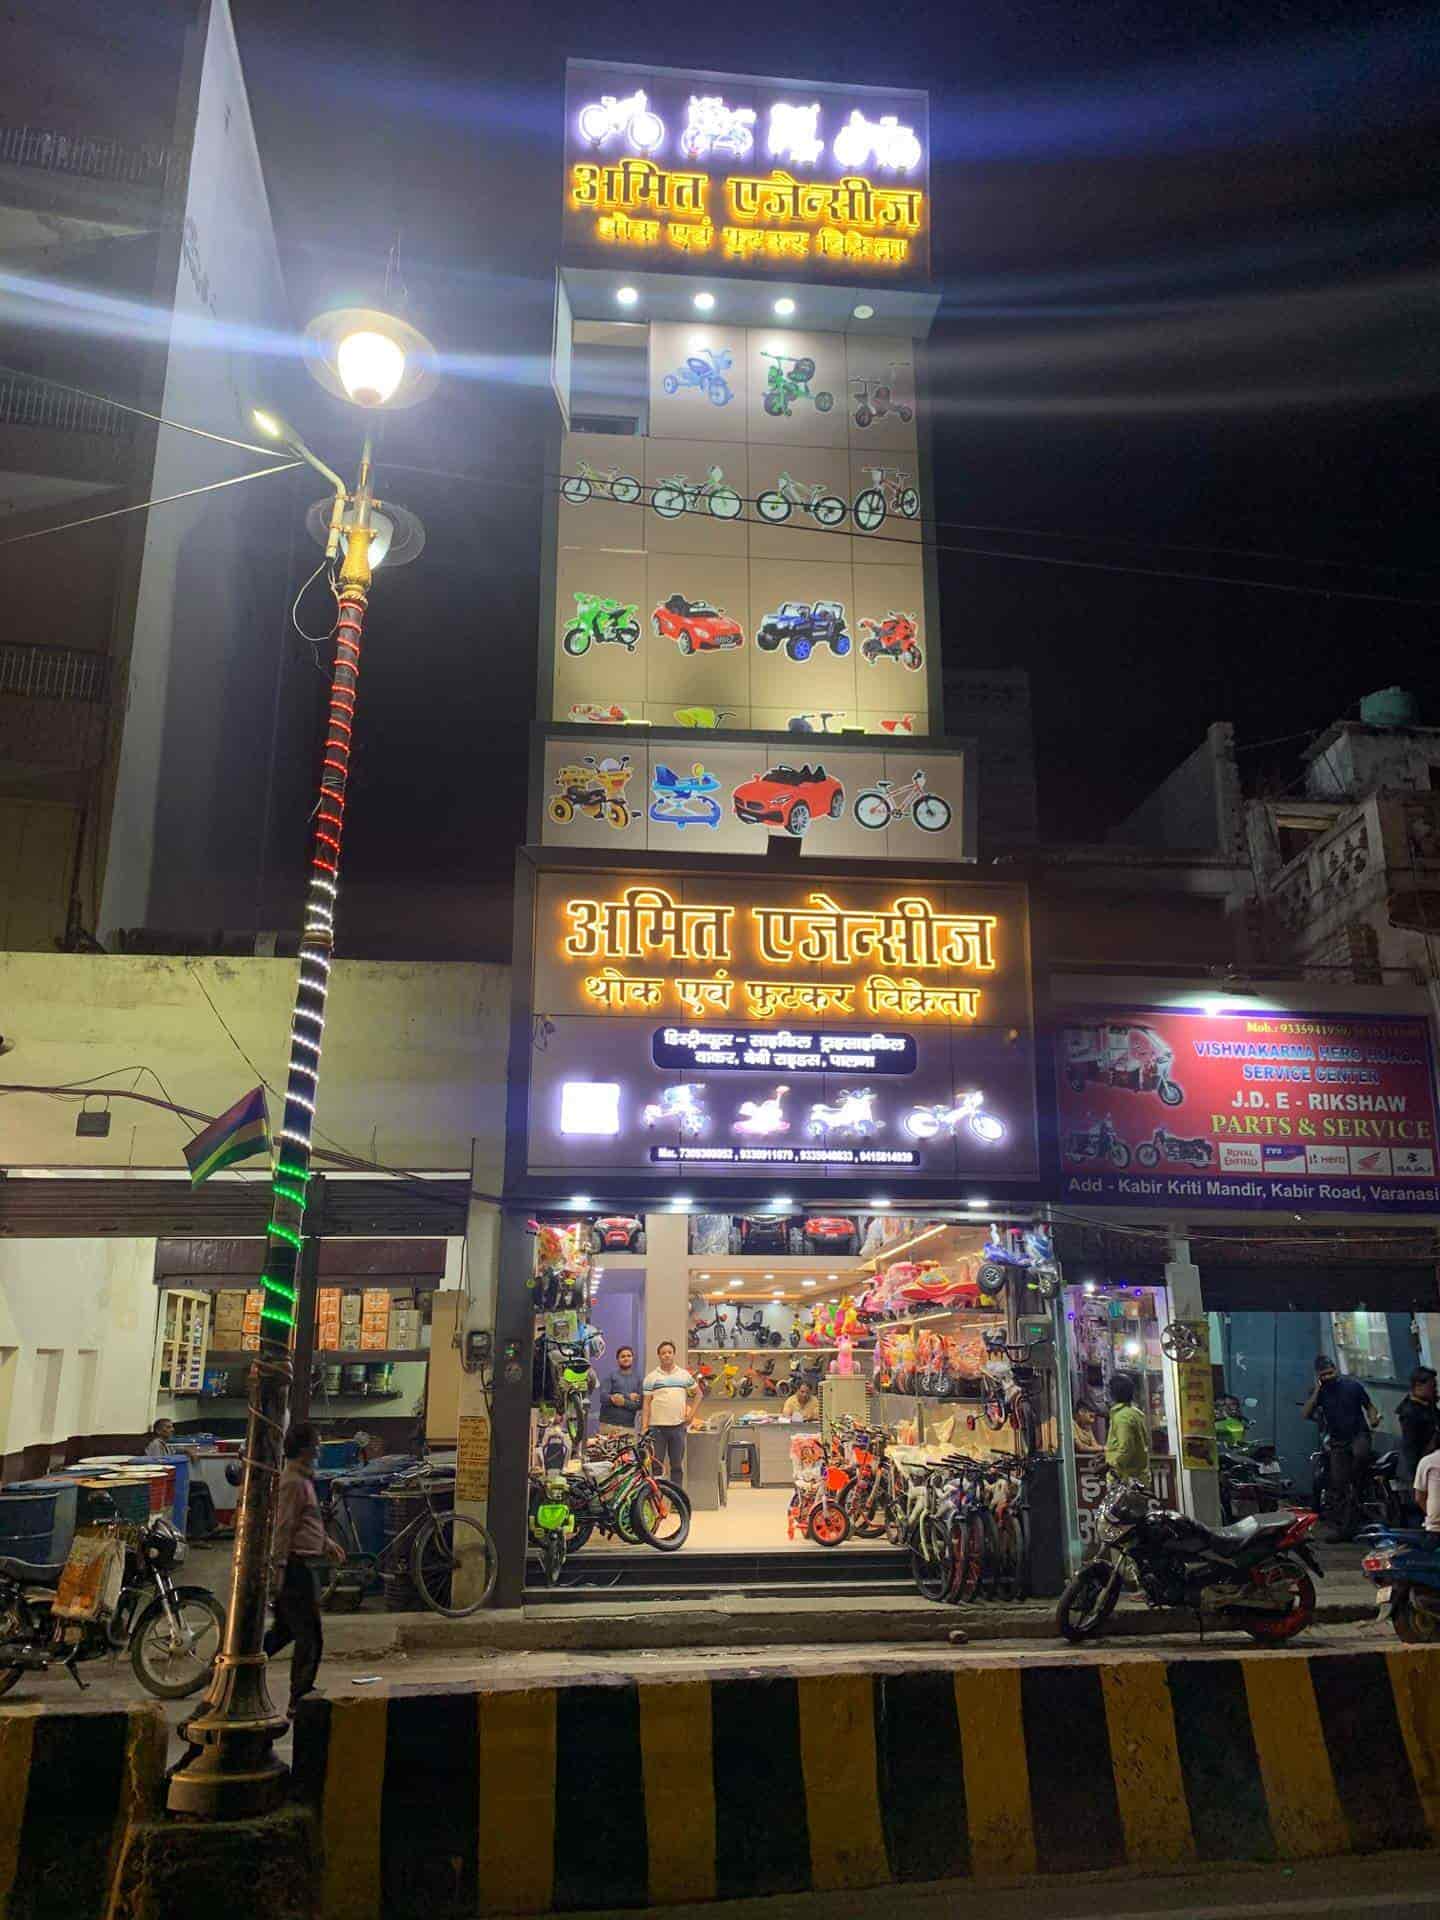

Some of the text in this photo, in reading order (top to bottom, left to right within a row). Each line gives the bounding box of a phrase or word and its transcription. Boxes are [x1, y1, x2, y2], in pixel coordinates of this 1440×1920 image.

[573, 159, 923, 229] अमित एजेन्सीज
[566, 887, 997, 970] अमित एजेन्सीज
[585, 967, 981, 1019] थोक एवं फुटकर विक्रेता
[1194, 1040, 1315, 1061] VISHWAKARMA
[1243, 1065, 1380, 1085] SERVICE CENTER
[1231, 1091, 1270, 1109] J.D.
[1276, 1092, 1290, 1109] E
[1308, 1094, 1407, 1112] RIKSHAW
[1211, 1114, 1431, 1139] PARTS & SERVICE
[1068, 1178, 1103, 1193] Add
[1118, 1179, 1163, 1194] Kabir
[1167, 1180, 1202, 1195] Kriti
[1206, 1182, 1267, 1199] Mandir,
[1271, 1183, 1315, 1199] Kabir
[1319, 1184, 1366, 1201] Road,
[1369, 1186, 1440, 1201] Varanasi
